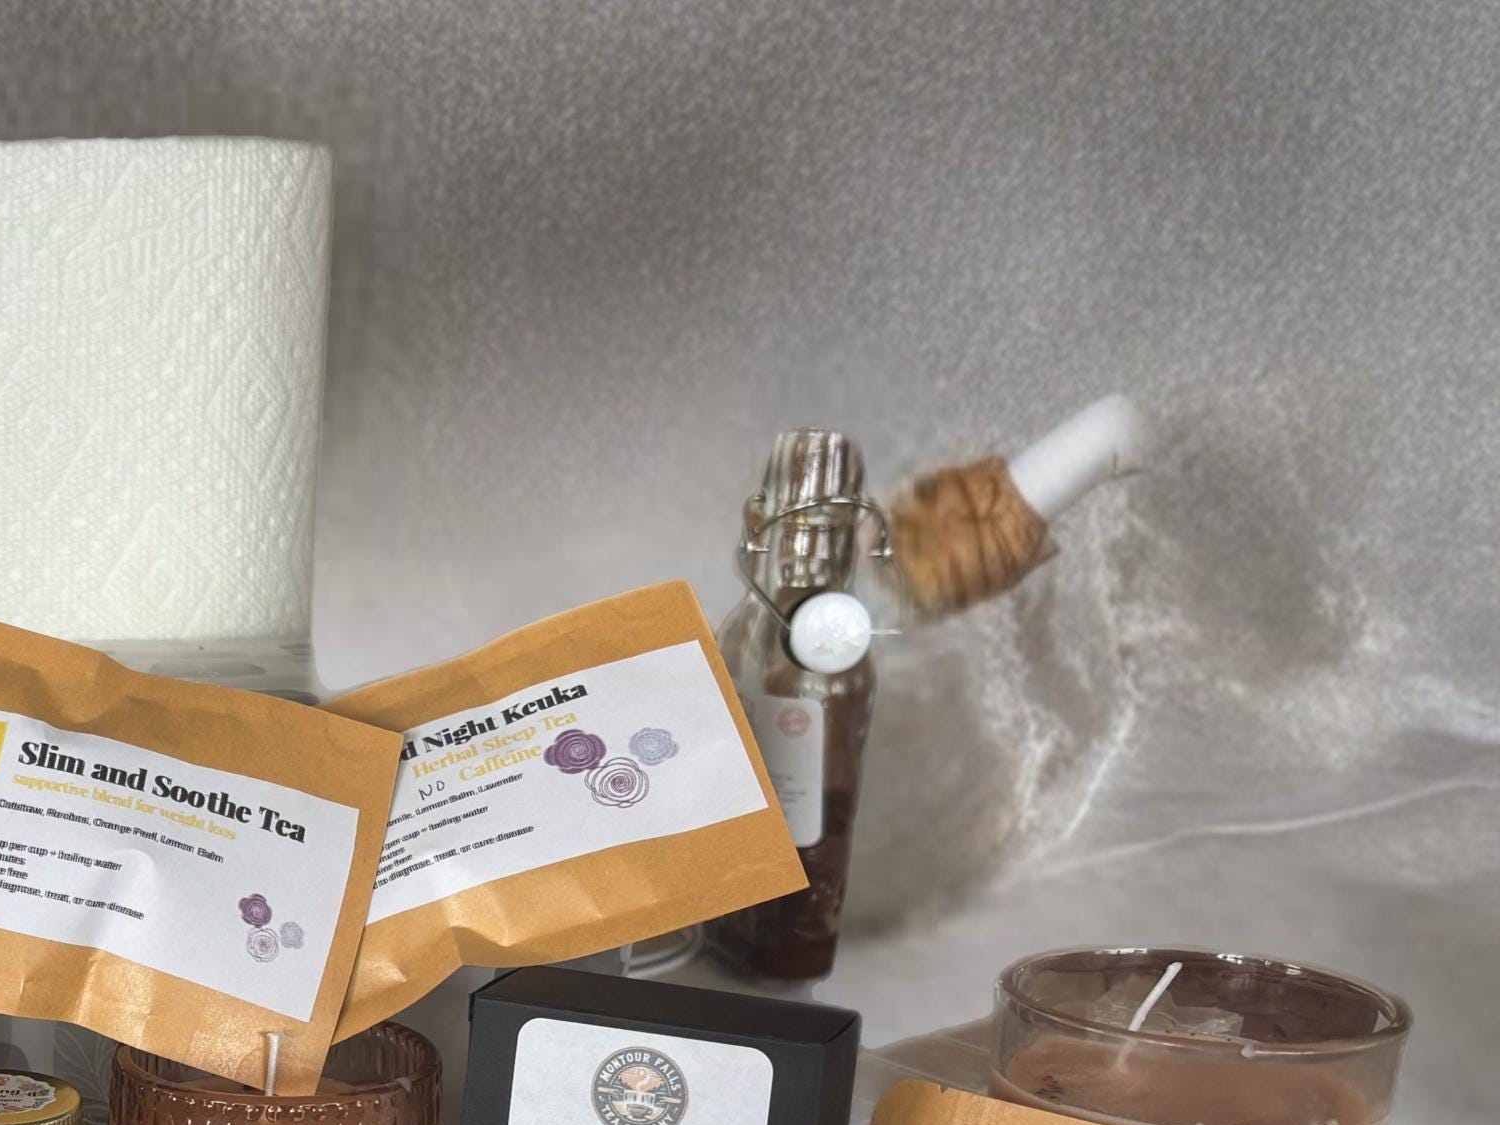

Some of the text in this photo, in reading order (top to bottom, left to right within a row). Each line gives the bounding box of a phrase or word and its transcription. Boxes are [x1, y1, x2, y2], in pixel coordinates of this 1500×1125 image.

[411, 744, 478, 779] Herbal
[483, 725, 537, 750] Sleep
[542, 712, 577, 732] Tea
[457, 746, 540, 781] Caffeine
[12, 774, 87, 796] supportive
[17, 741, 86, 777] Slim
[90, 763, 148, 793] and
[151, 775, 252, 824] Soothe
[258, 806, 306, 844] Tea
[418, 780, 445, 801] NO
[600, 1052, 681, 1091] MONTOUR FALLS
